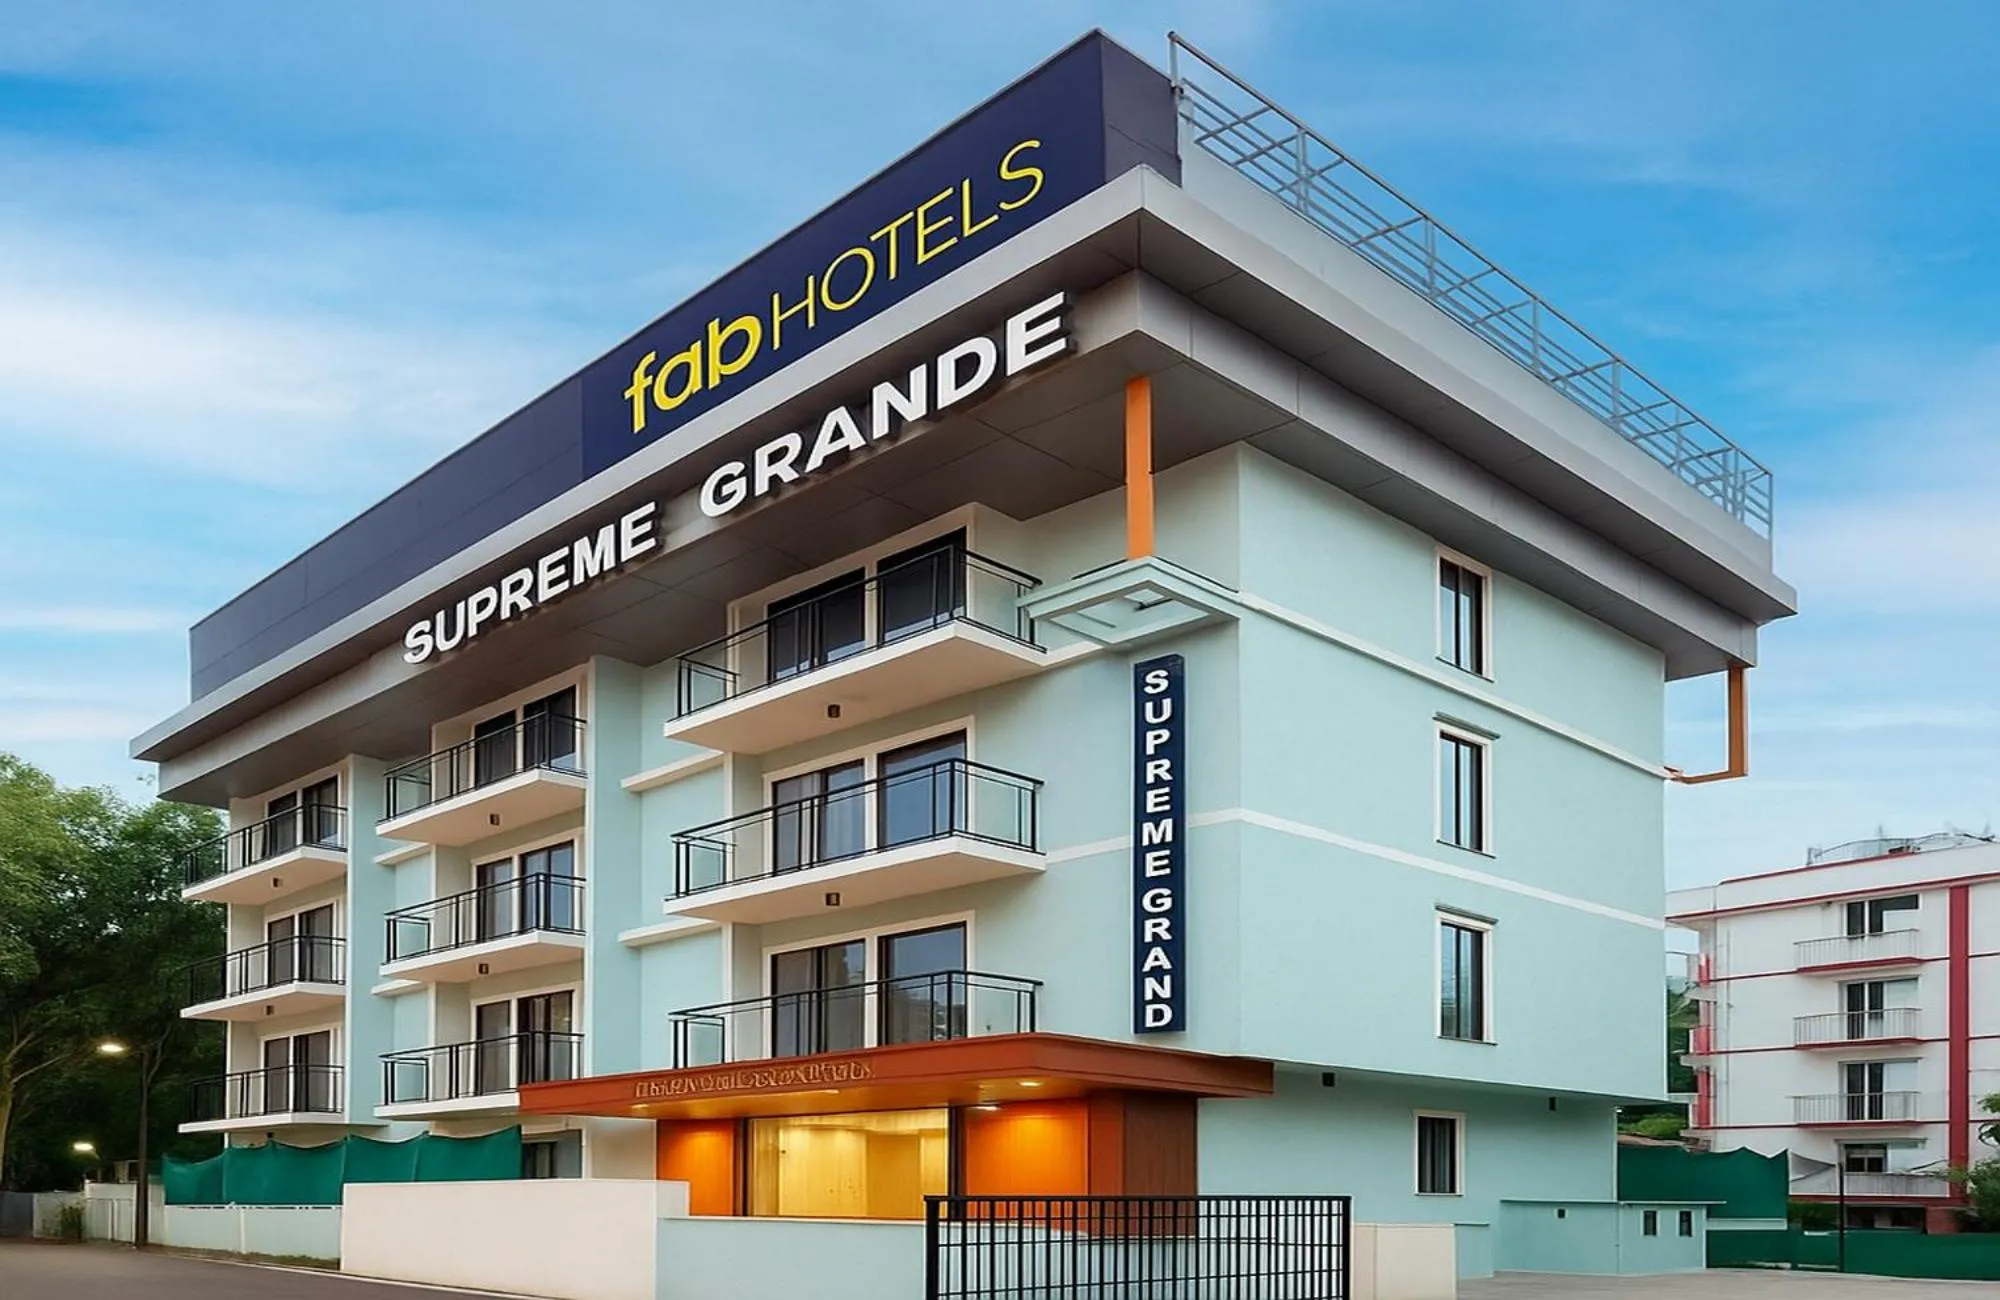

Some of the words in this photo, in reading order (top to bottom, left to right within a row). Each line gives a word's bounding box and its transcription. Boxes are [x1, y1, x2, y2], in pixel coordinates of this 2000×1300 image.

[402, 501, 658, 664] SUPREME
[700, 291, 1068, 518] GRANDE
[1141, 669, 1174, 878] SUPREME
[1141, 887, 1174, 1029] GRAND
